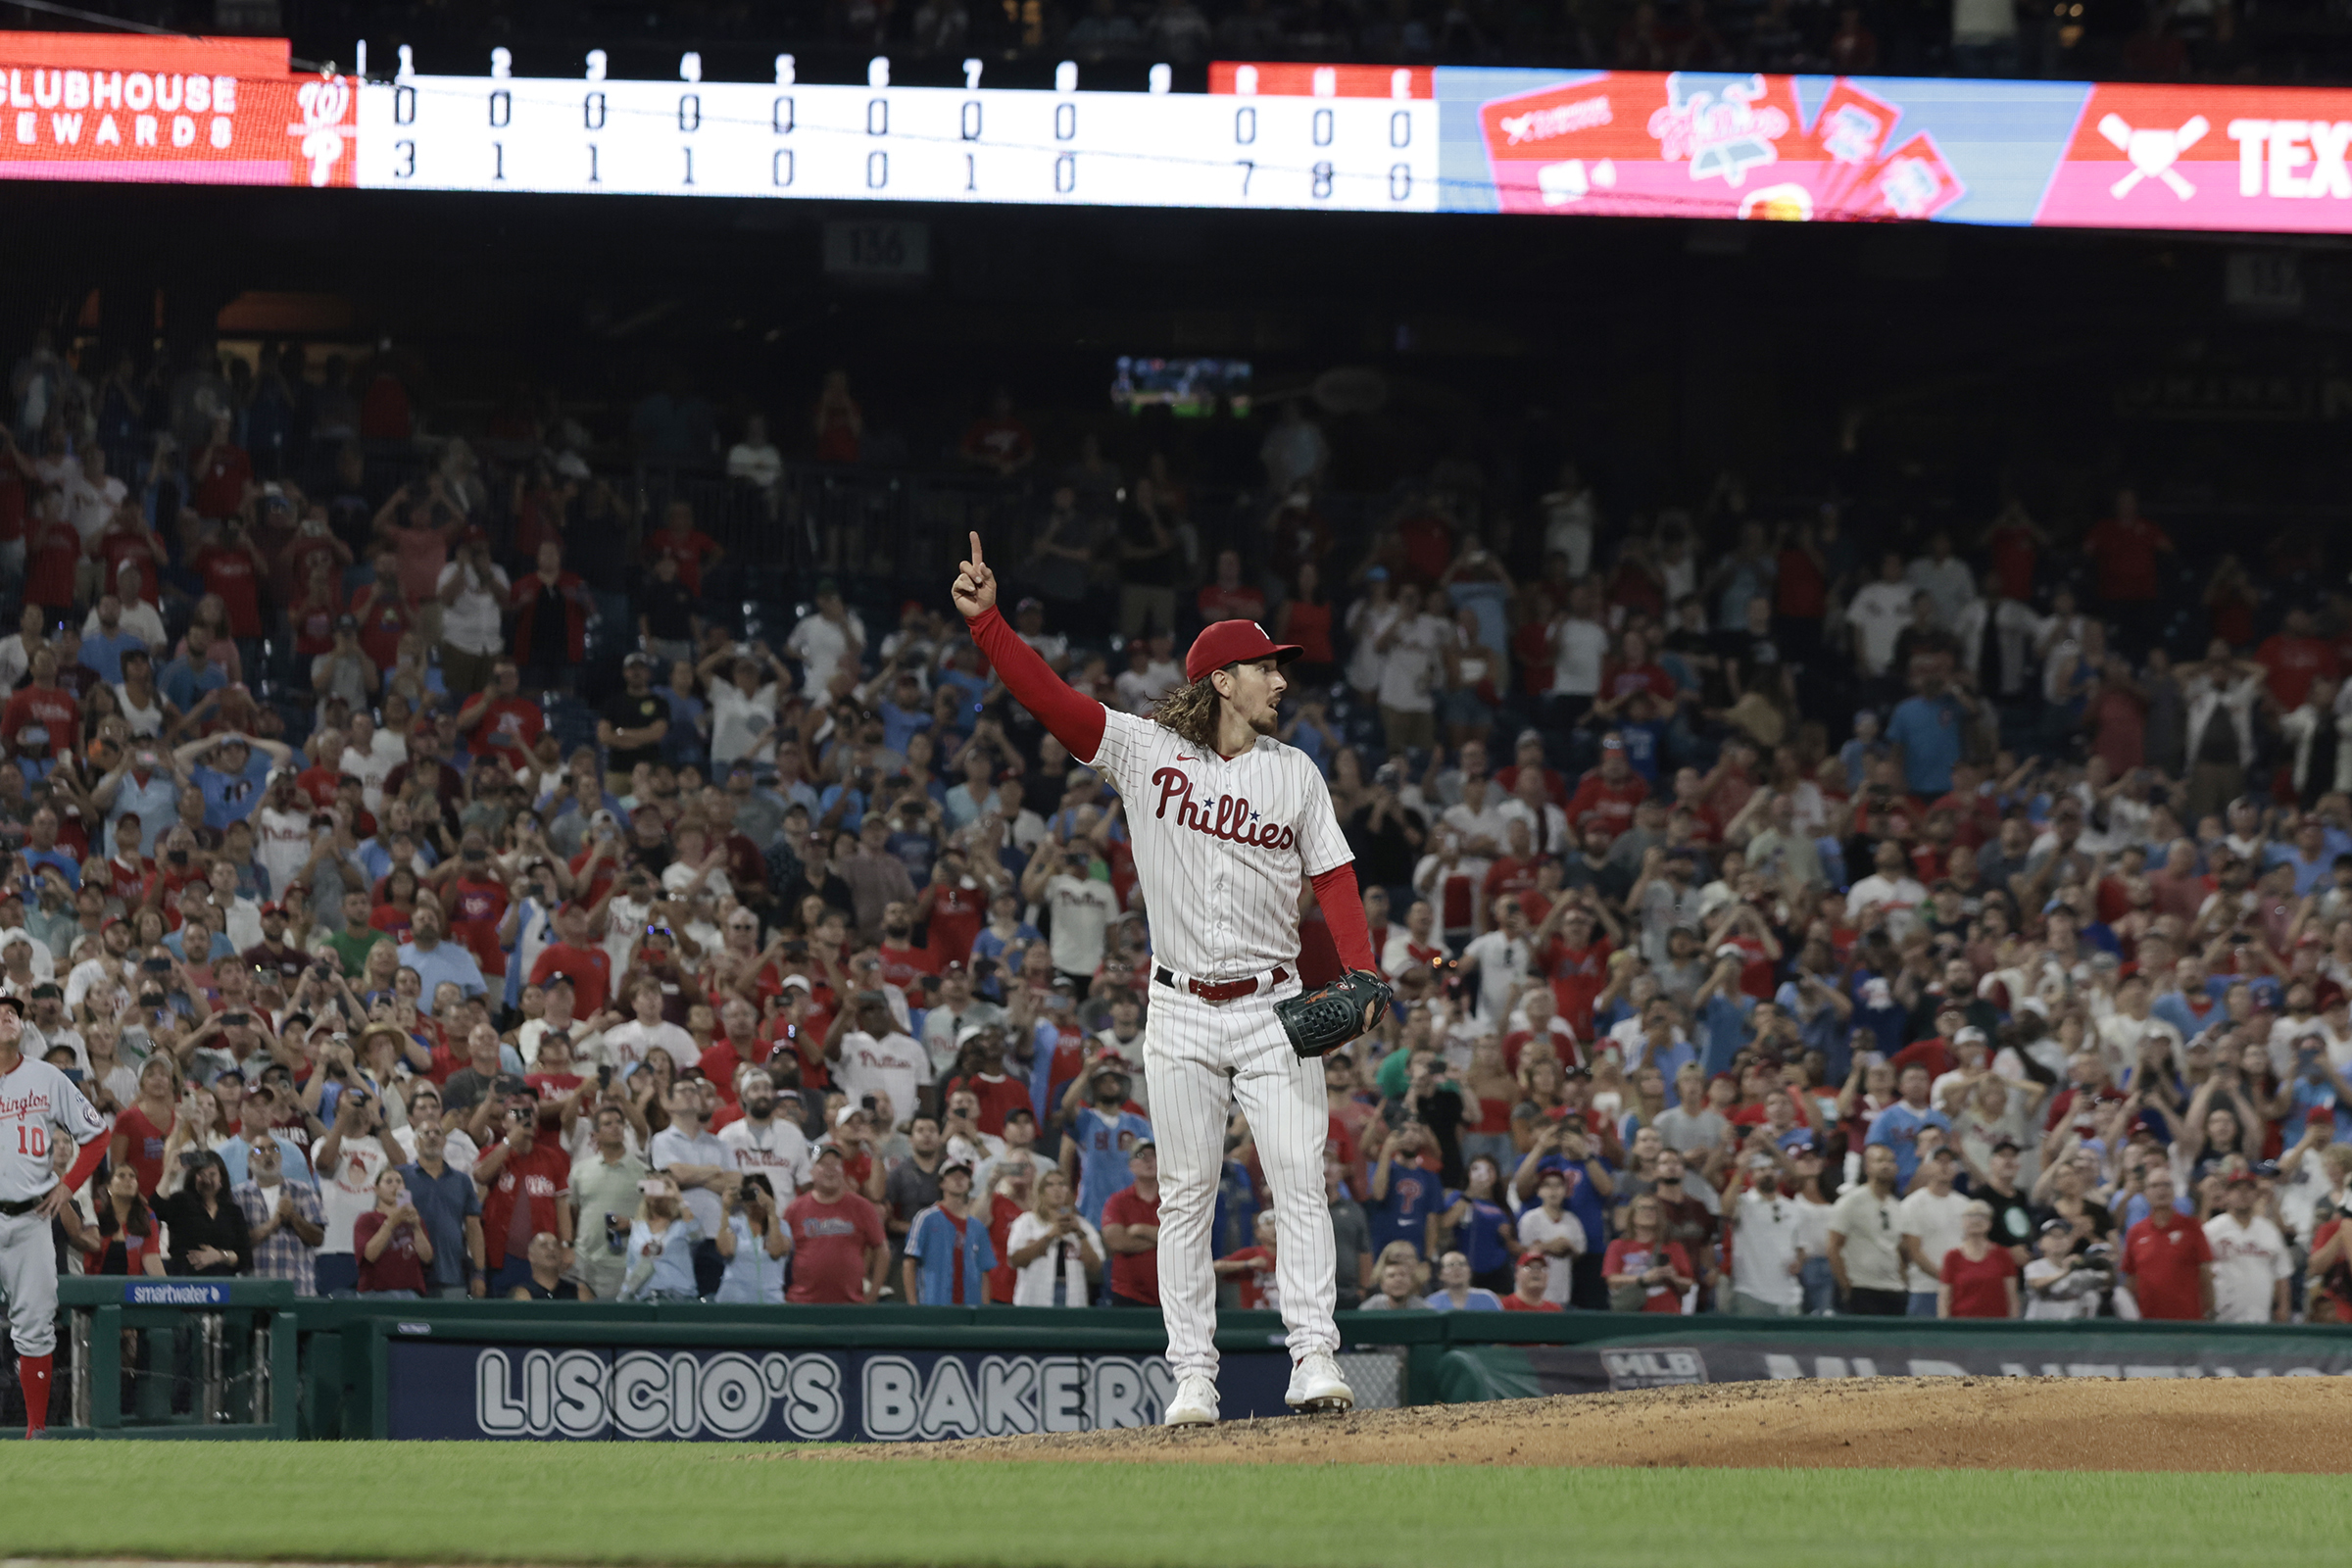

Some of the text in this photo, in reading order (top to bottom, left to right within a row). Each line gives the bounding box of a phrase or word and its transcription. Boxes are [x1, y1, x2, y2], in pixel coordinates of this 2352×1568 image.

[398, 45, 416, 75] 1
[491, 48, 513, 77] 2
[585, 50, 608, 79] 3
[679, 52, 702, 81] 4
[962, 60, 983, 87] 7
[394, 86, 1411, 148] 0 0 0 0 0 0 0 0 0 0 0
[394, 140, 1412, 202] 3 1 1 1 0 0 1 0 7 8 0
[1152, 766, 1294, 850] Phillies
[18, 1125, 45, 1156] 10
[134, 1284, 210, 1303] smartwater
[1608, 1352, 1698, 1377] MLB
[476, 1348, 844, 1439] LISCIO'S
